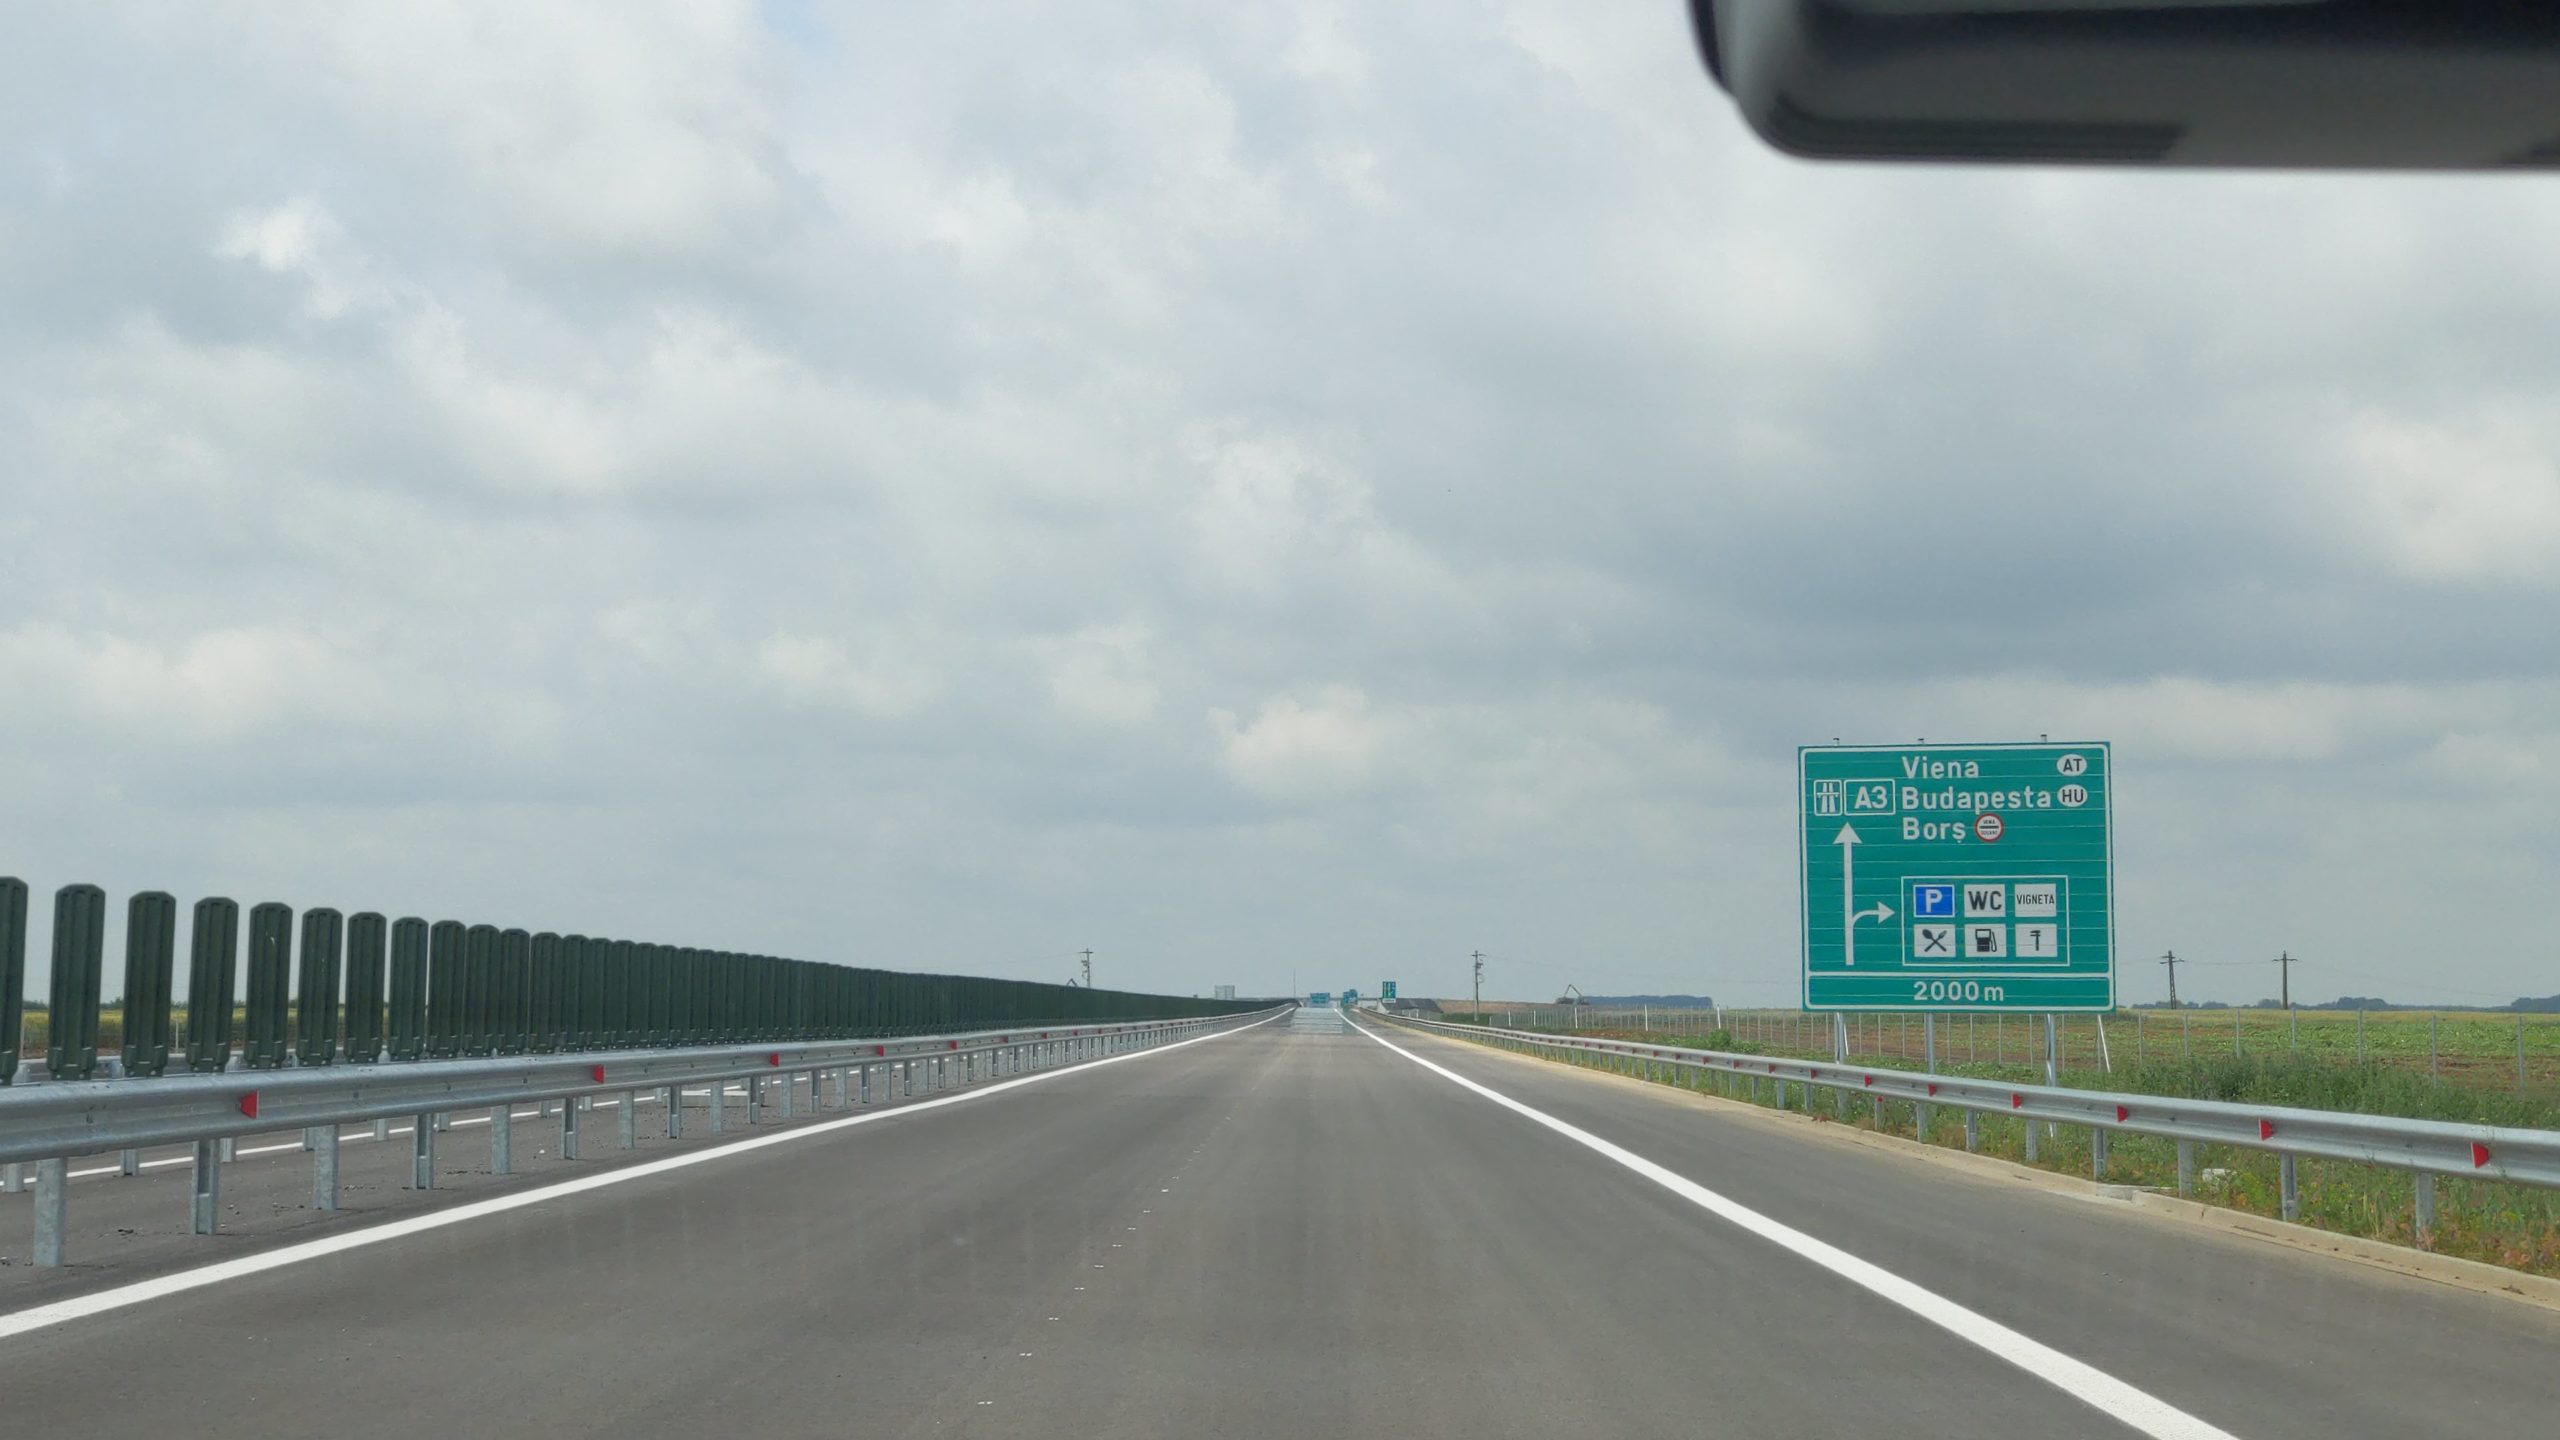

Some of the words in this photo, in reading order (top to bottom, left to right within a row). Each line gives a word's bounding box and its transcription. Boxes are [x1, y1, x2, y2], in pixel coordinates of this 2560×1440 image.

[1902, 756, 1979, 779] Viena
[2063, 758, 2083, 772] AT
[1854, 786, 1888, 808] A3
[1902, 786, 2051, 814] Budapesta
[2061, 789, 2084, 803] HU
[1924, 889, 1943, 913] P
[1968, 891, 2002, 910] WC
[2016, 894, 2055, 905] VIGNETA
